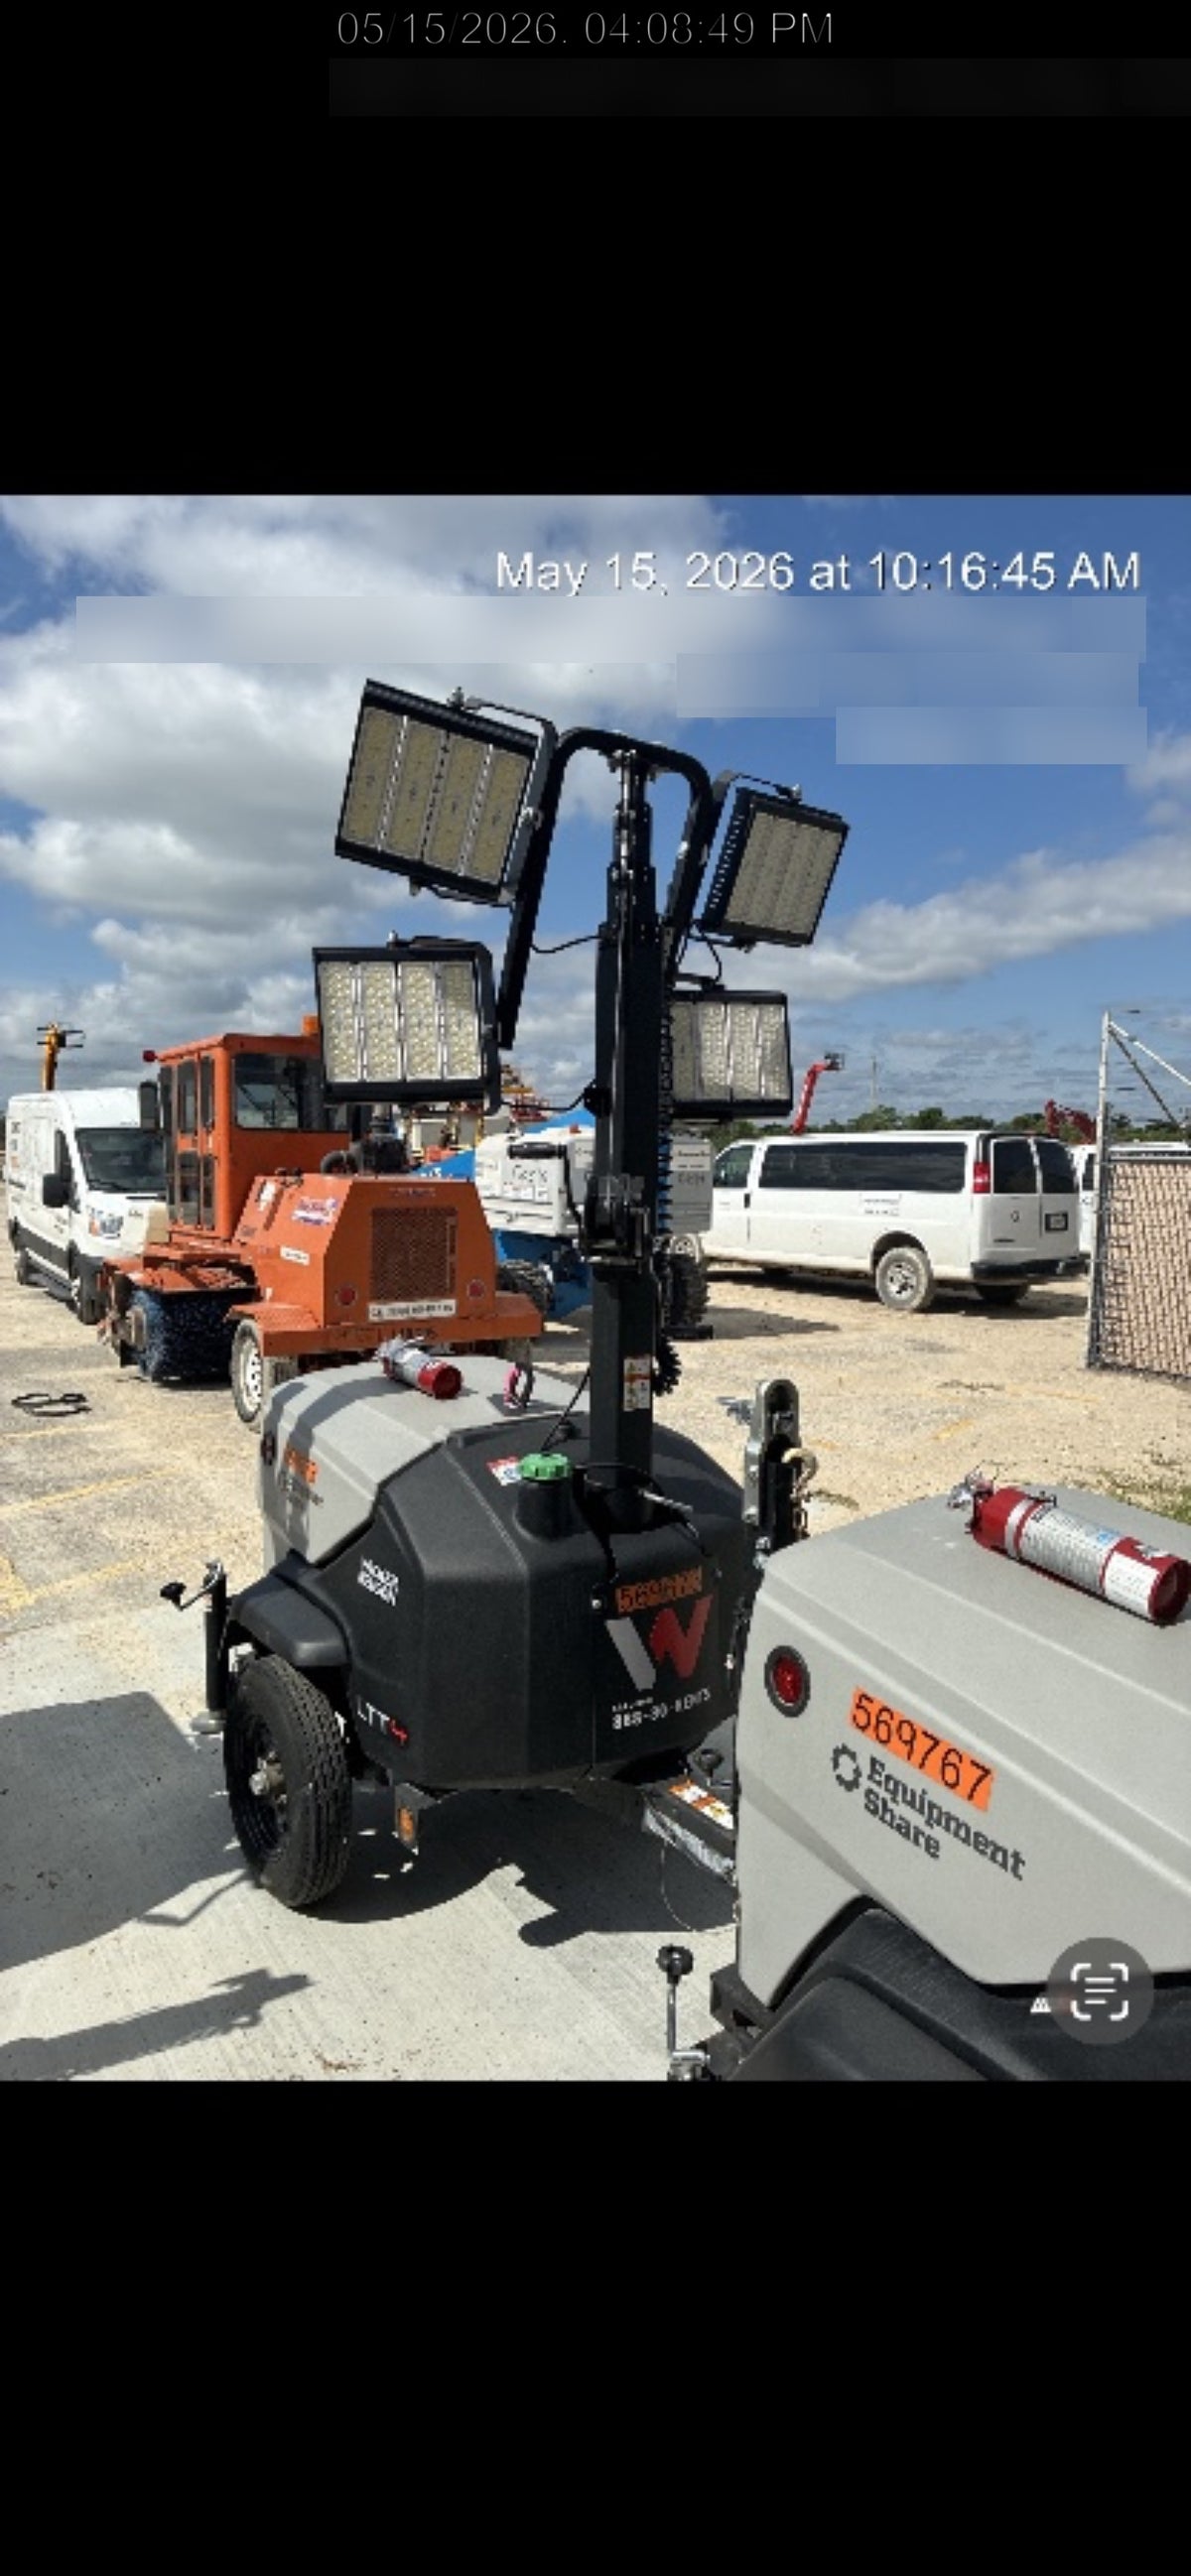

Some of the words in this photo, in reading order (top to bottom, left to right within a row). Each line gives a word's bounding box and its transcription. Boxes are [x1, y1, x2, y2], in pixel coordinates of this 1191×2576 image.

[852, 1692, 992, 1802] 569767
[863, 1787, 941, 1861] Share
[866, 1754, 1026, 1881] Equipment
